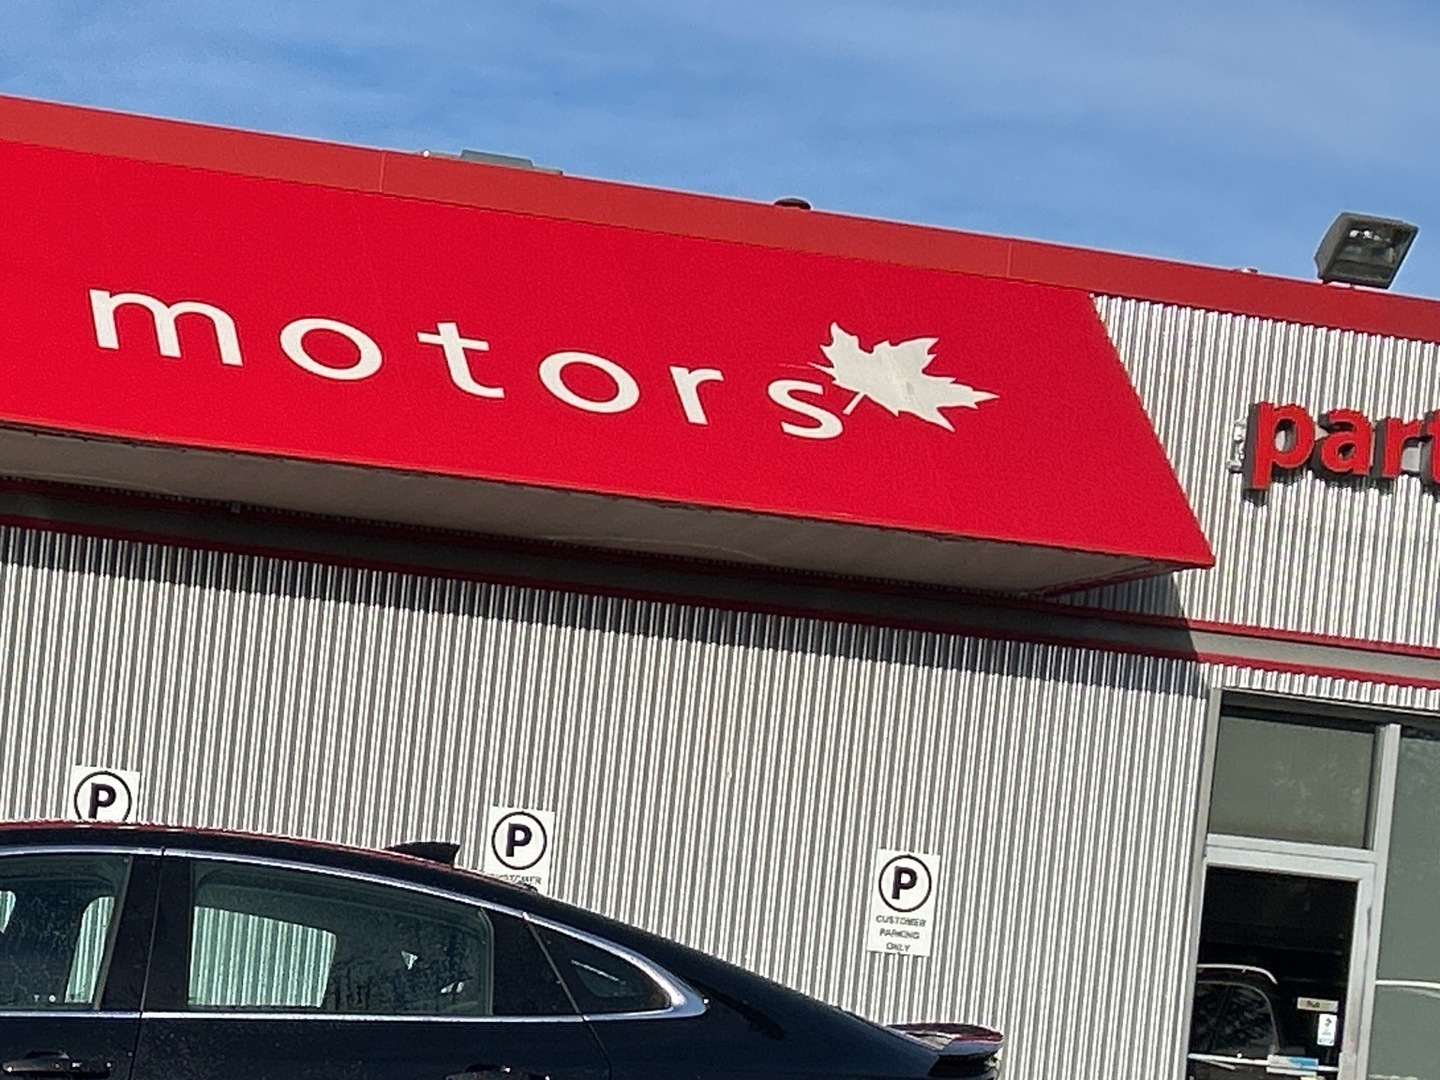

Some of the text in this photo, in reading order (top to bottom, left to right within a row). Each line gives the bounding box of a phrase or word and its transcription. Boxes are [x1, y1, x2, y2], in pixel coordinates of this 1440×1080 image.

[89, 289, 845, 440] motors
[88, 782, 116, 819] P
[505, 822, 532, 857] P
[891, 865, 918, 900] P
[875, 915, 927, 927] CUSTOMER
[879, 927, 921, 940] PARKING
[885, 942, 911, 952] ONLY
